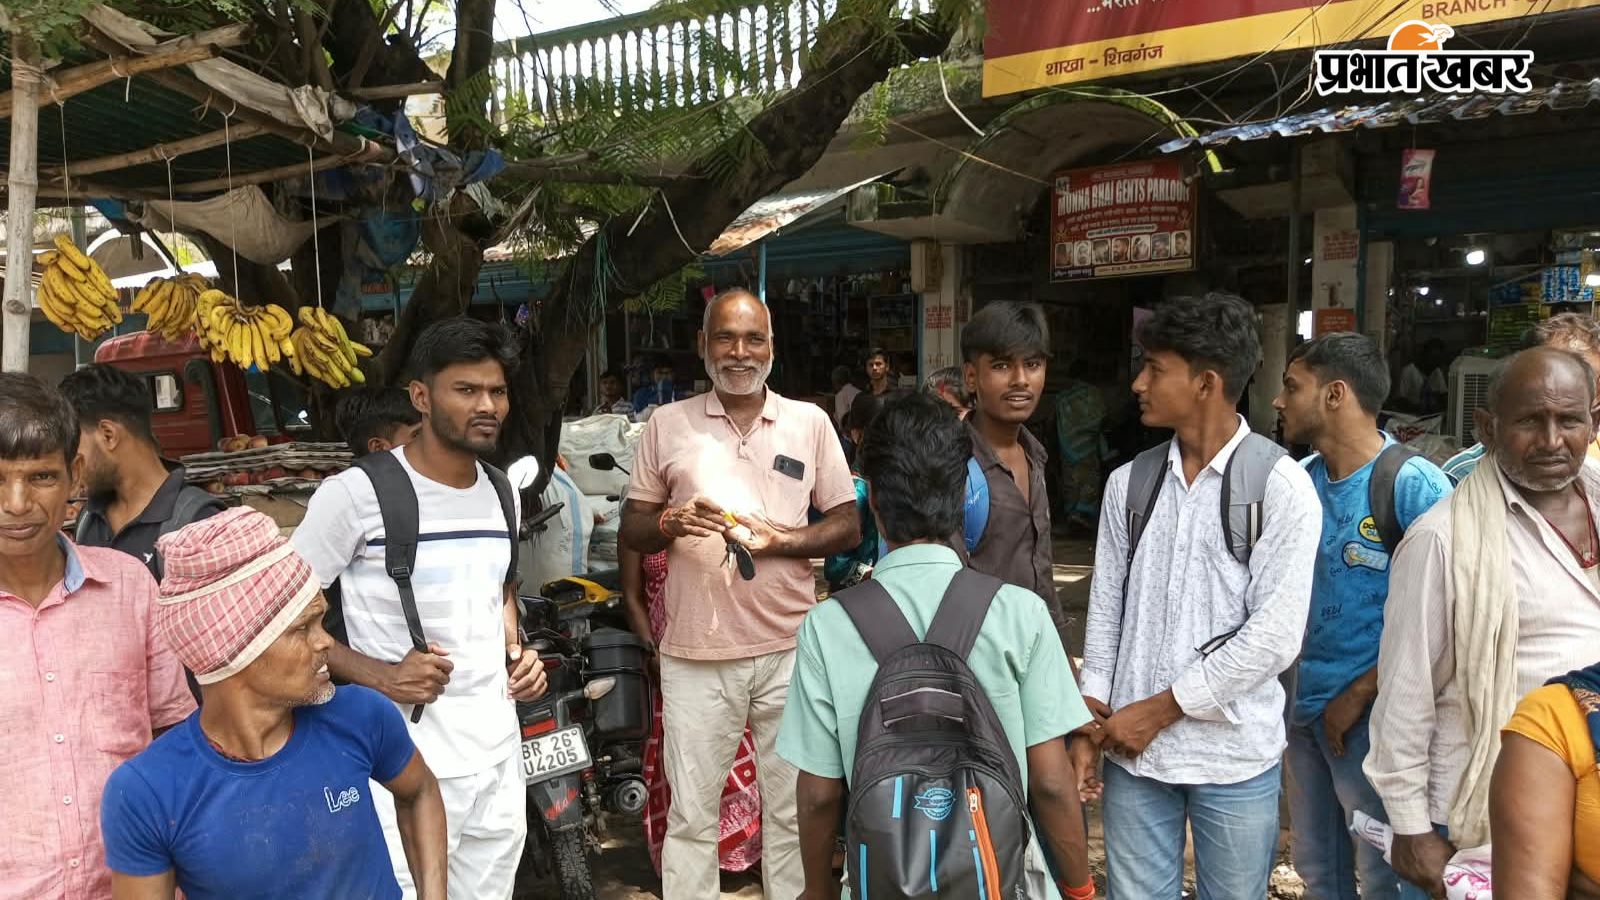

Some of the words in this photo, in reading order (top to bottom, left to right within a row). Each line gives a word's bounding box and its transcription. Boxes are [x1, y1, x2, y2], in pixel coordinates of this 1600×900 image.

[1422, 0, 1508, 20] BRANCH
[1045, 57, 1085, 76] शाखा
[1103, 44, 1164, 67] शिवगंज
[1057, 186, 1091, 217] MUNNA
[1092, 180, 1114, 209] BHAI
[1116, 178, 1146, 205] GENTS
[1147, 178, 1190, 203] PARLOUR
[521, 741, 542, 759] BR
[550, 732, 572, 752] 26
[523, 747, 579, 776] U4205
[323, 786, 360, 813] Lee
